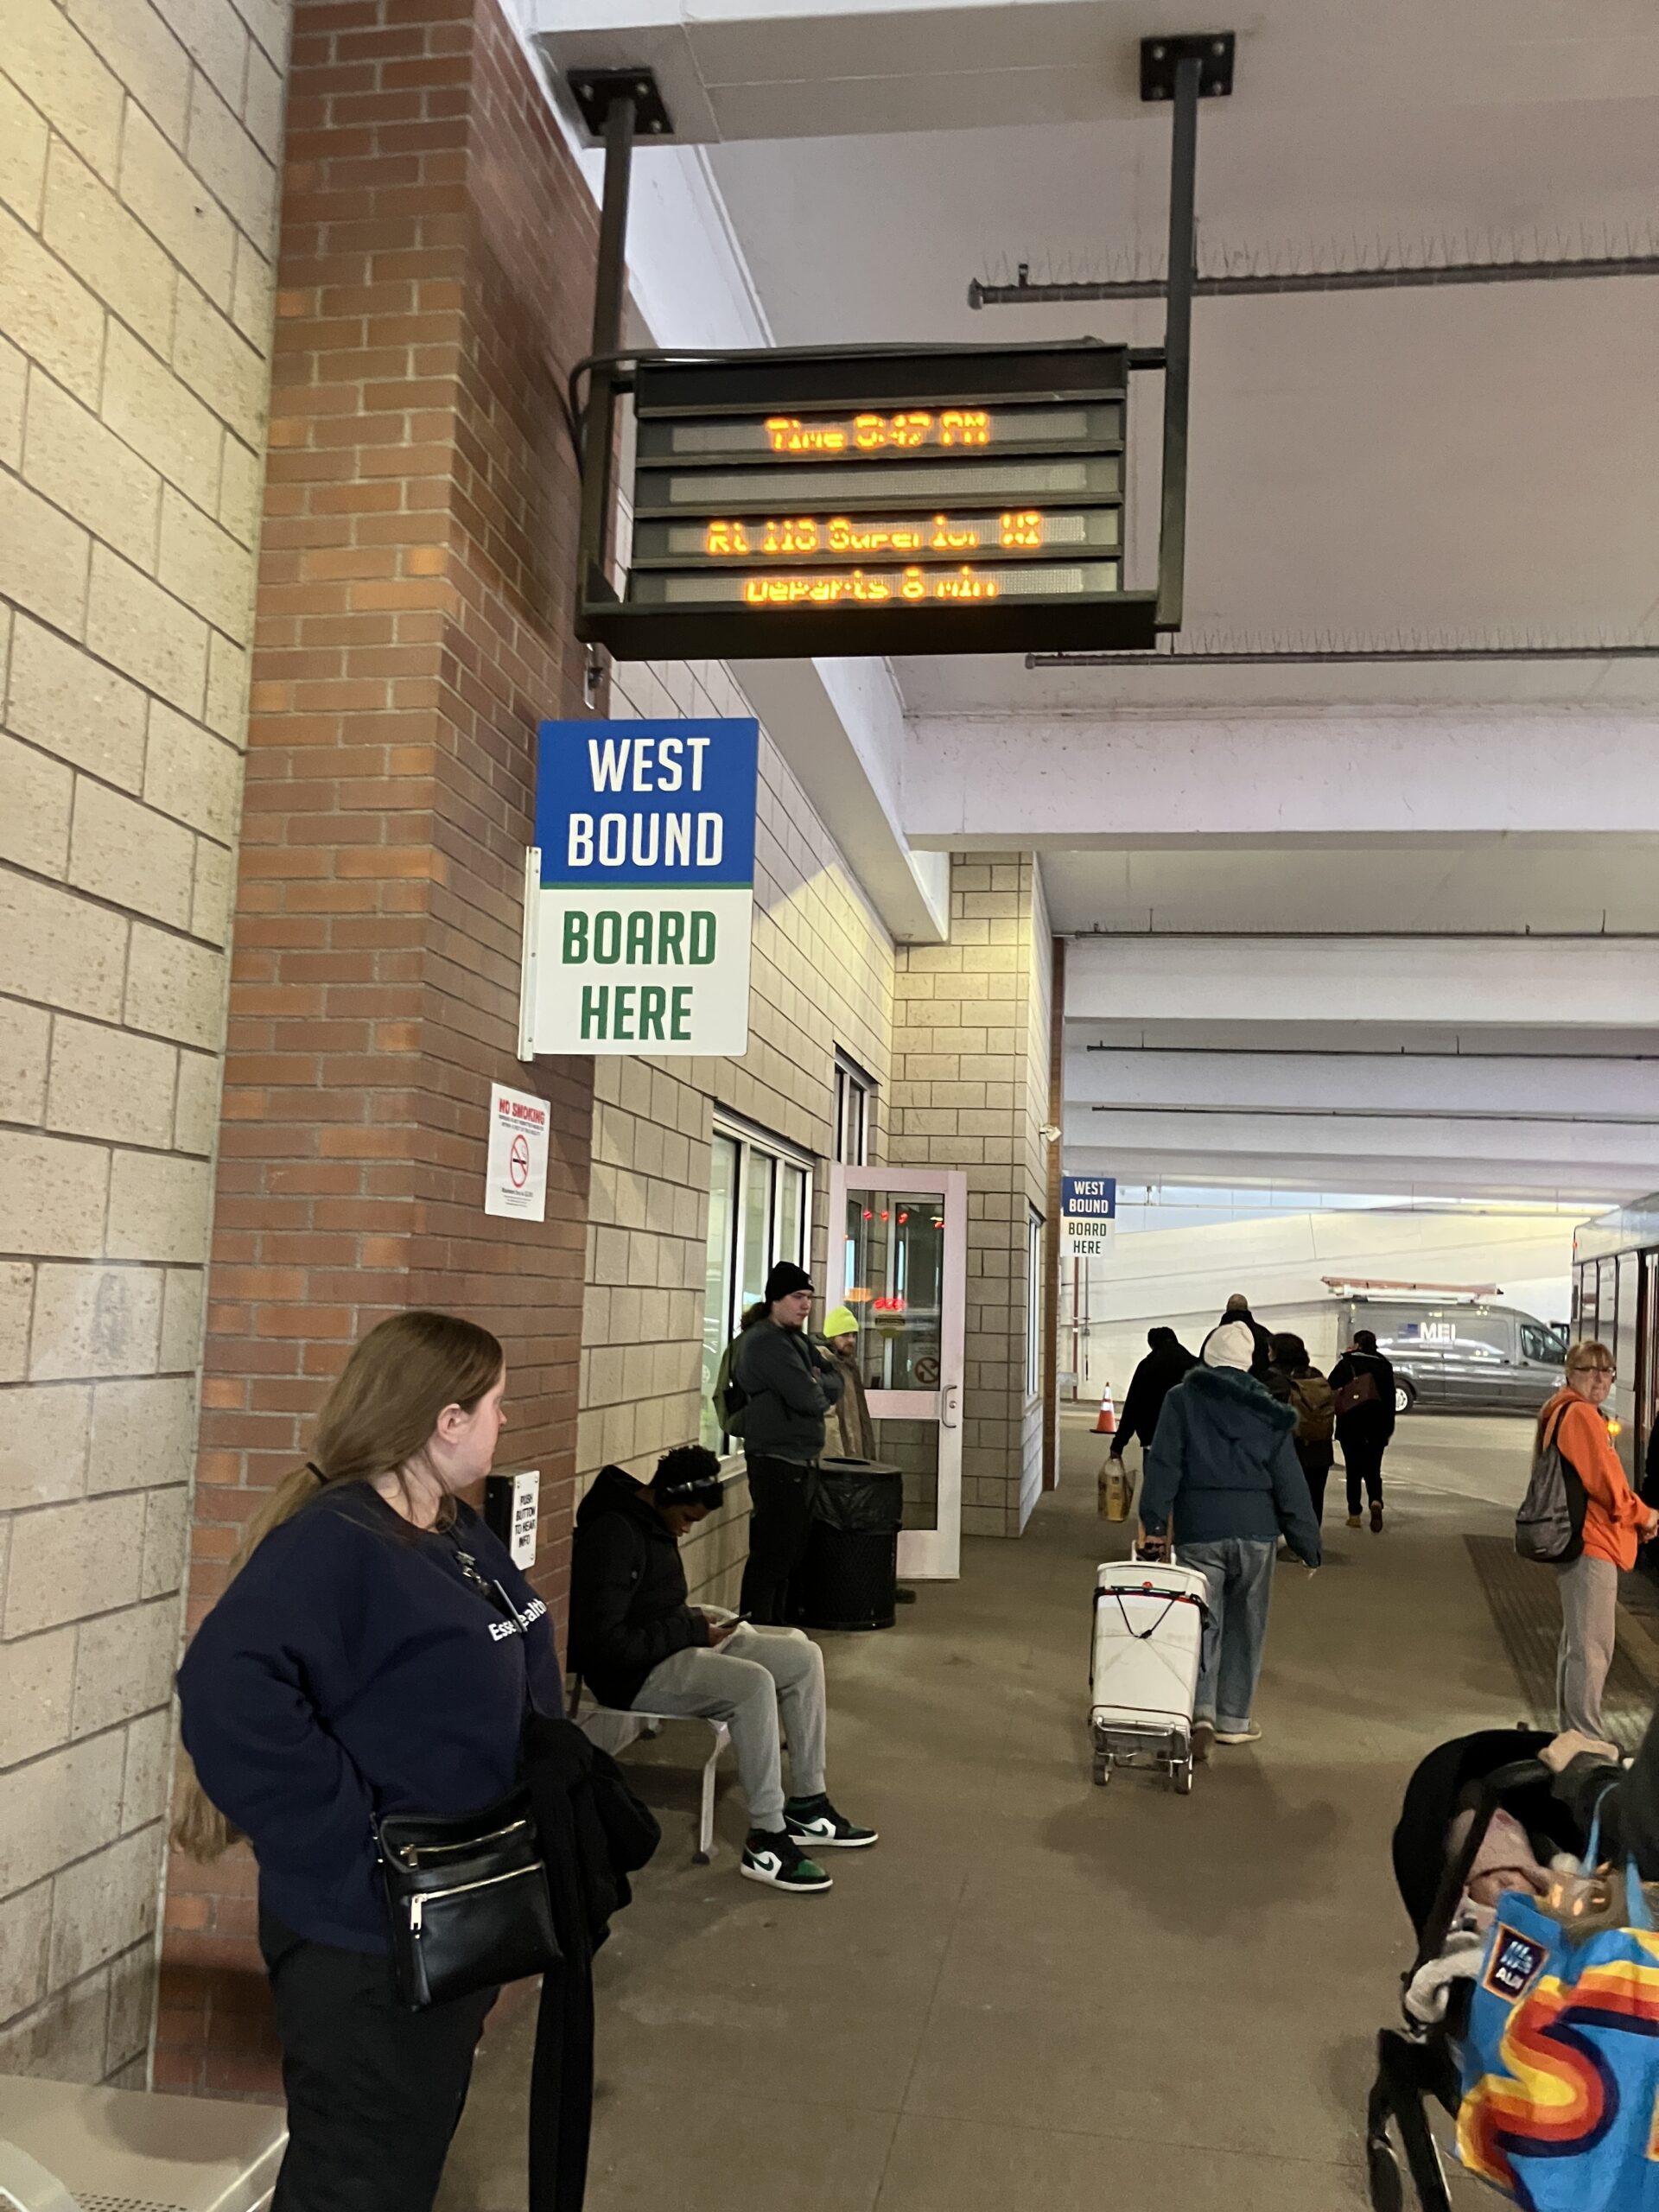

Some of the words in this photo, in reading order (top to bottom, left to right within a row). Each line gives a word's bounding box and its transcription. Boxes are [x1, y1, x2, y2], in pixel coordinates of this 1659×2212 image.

[766, 417, 845, 450] Time
[941, 410, 988, 446] PM
[746, 569, 890, 602] Departs
[935, 565, 998, 599] min
[588, 737, 710, 792] WEST
[567, 811, 724, 868] BOUND
[562, 910, 716, 966] BOARD
[580, 985, 694, 1040] HERE
[499, 1098, 510, 1115] NO
[512, 1102, 545, 1126] SMOKING
[1074, 1180, 1105, 1196] WEST
[1069, 1198, 1109, 1214] BOUND
[1068, 1222, 1107, 1236] BOARD
[1073, 1240, 1102, 1255] HERE
[1420, 1322, 1456, 1342] MEI
